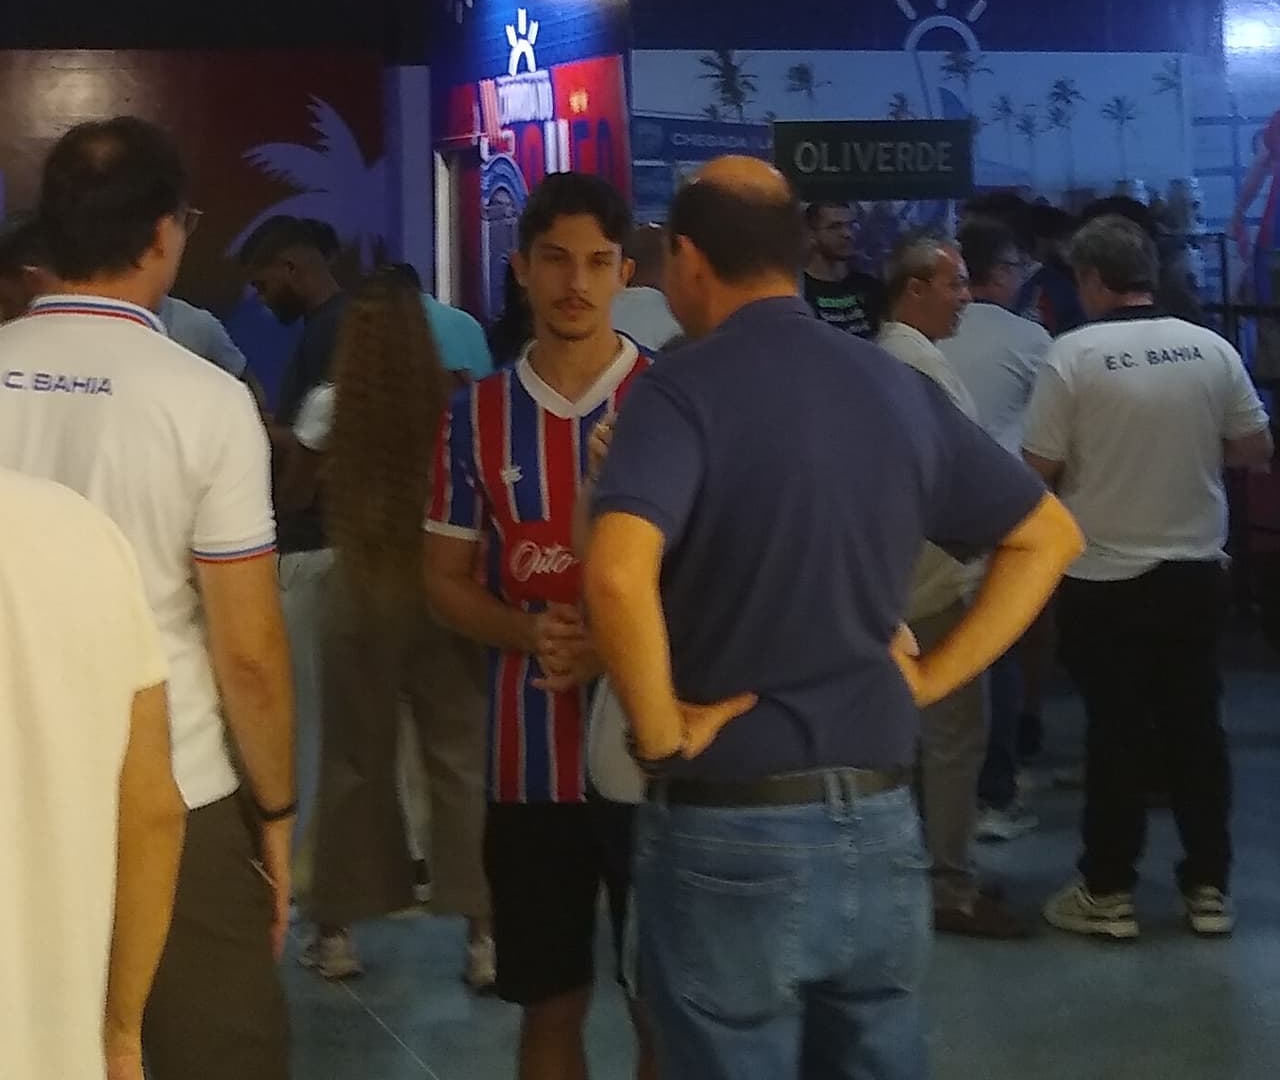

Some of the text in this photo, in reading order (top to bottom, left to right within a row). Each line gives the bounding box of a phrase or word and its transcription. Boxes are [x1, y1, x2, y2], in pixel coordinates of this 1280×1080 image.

[793, 141, 953, 173] OLIVERDE
[1145, 346, 1205, 366] BAHIA
[33, 372, 113, 396] BAHIA
